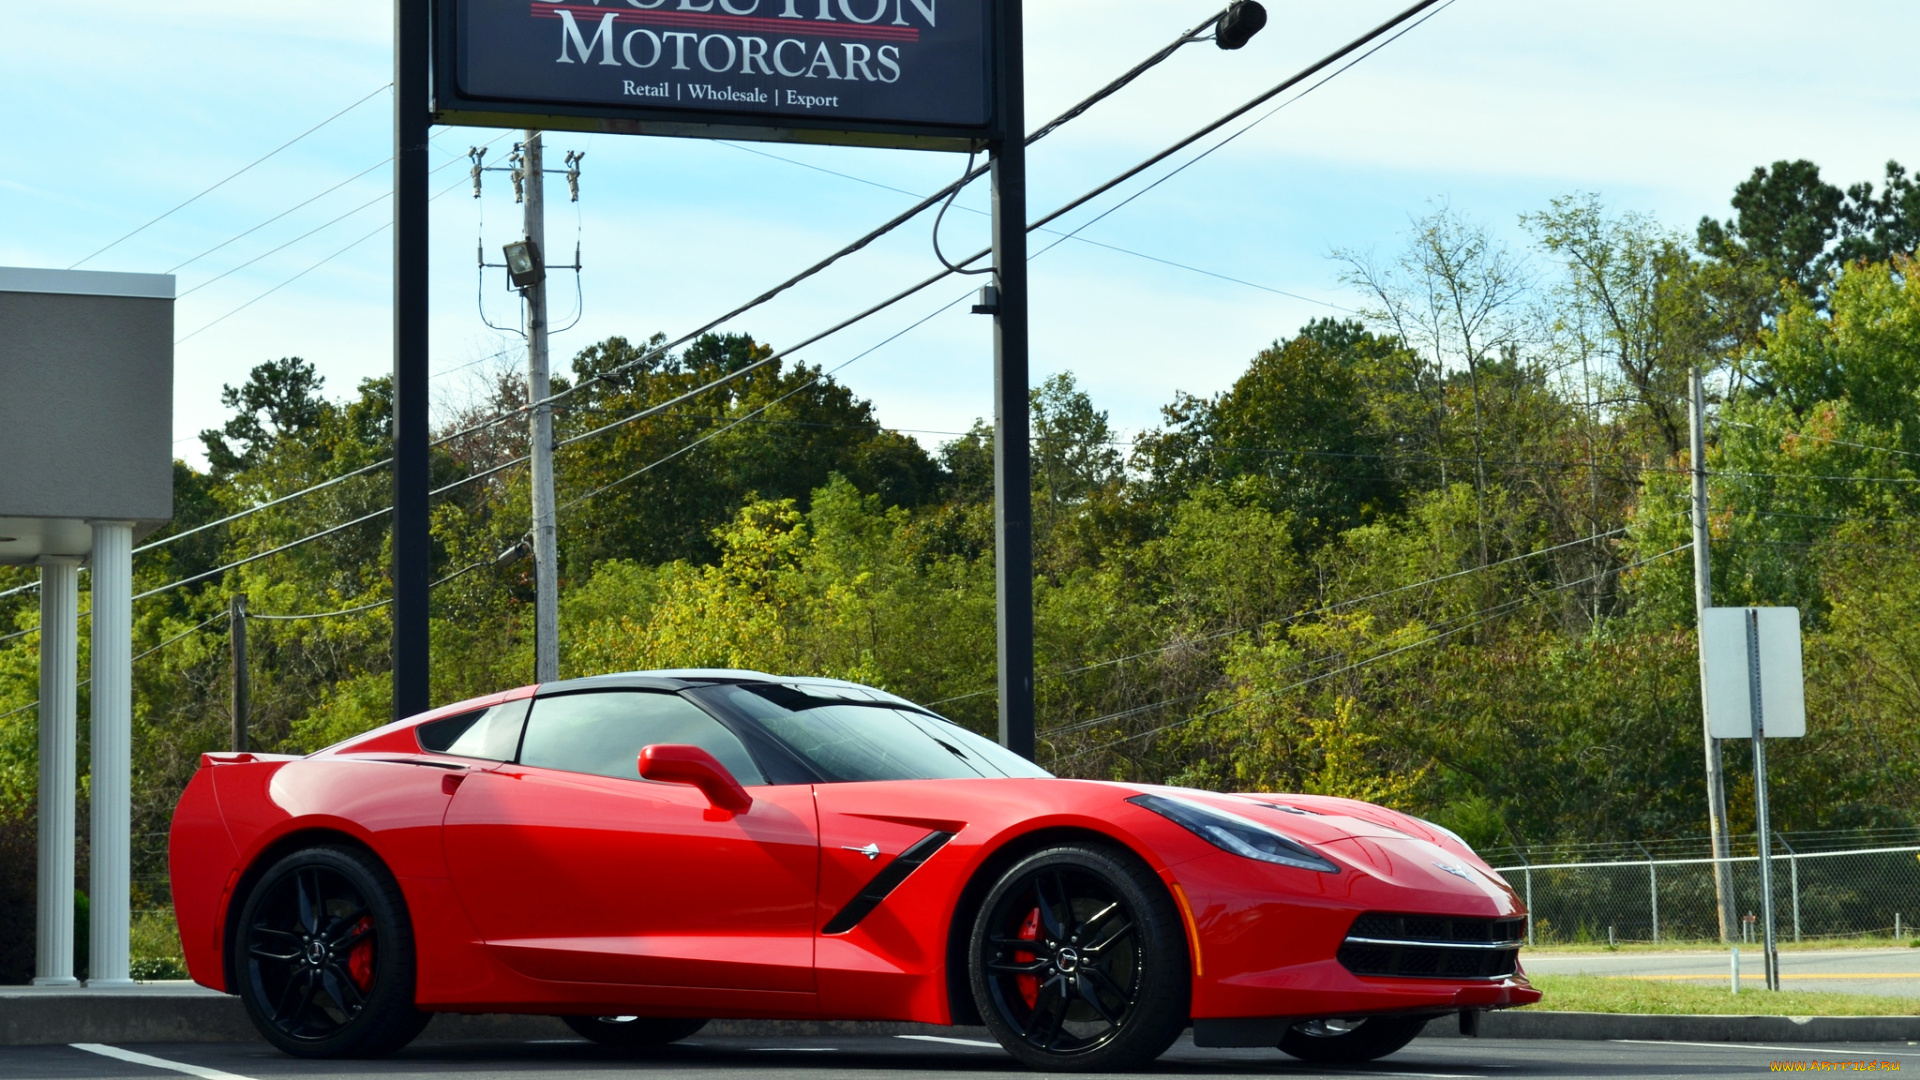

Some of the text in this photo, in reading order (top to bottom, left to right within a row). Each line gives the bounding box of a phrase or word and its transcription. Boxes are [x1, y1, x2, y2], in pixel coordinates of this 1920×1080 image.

[553, 9, 901, 84] MOTORCARS
[622, 80, 670, 98] Retail
[687, 84, 768, 103] Wholesale
[785, 89, 839, 109] Export
